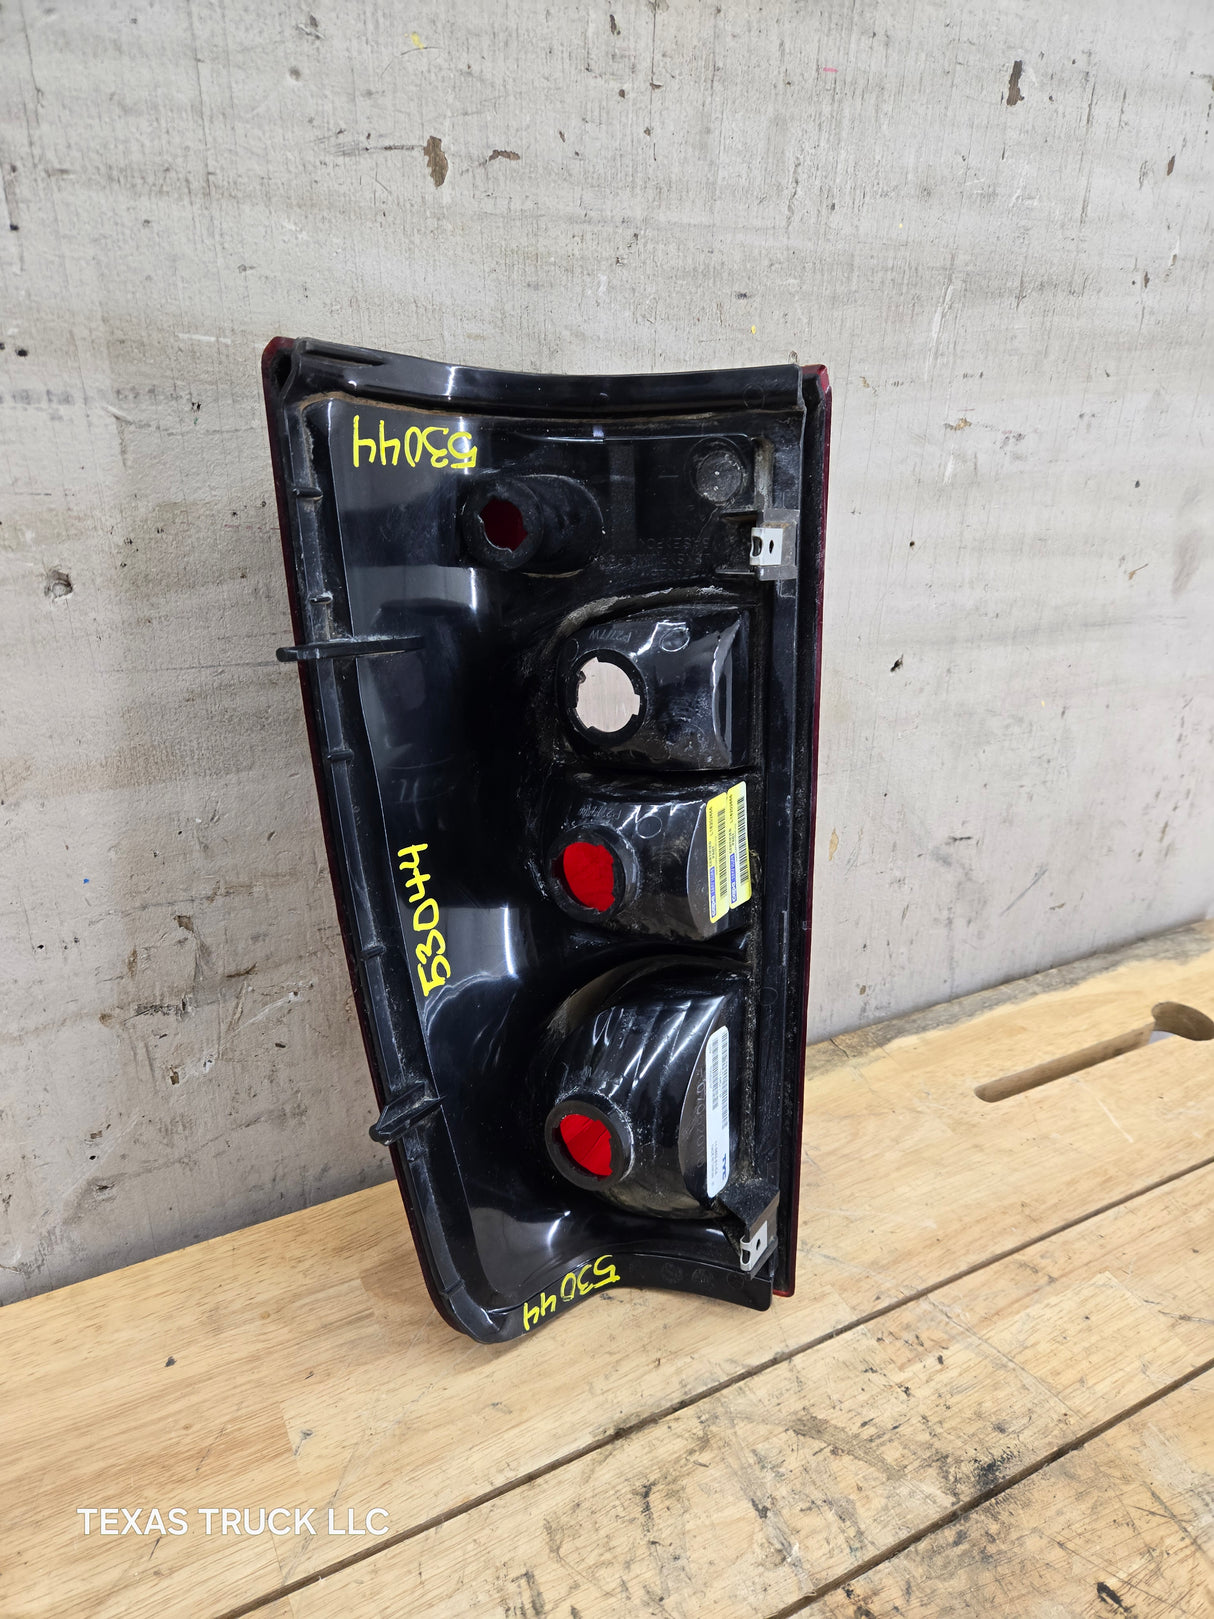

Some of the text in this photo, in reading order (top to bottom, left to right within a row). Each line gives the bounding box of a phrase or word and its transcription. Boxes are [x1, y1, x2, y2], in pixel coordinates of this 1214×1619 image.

[353, 415, 477, 469] 53044
[397, 843, 451, 997] 53044
[523, 1254, 621, 1331] 53044
